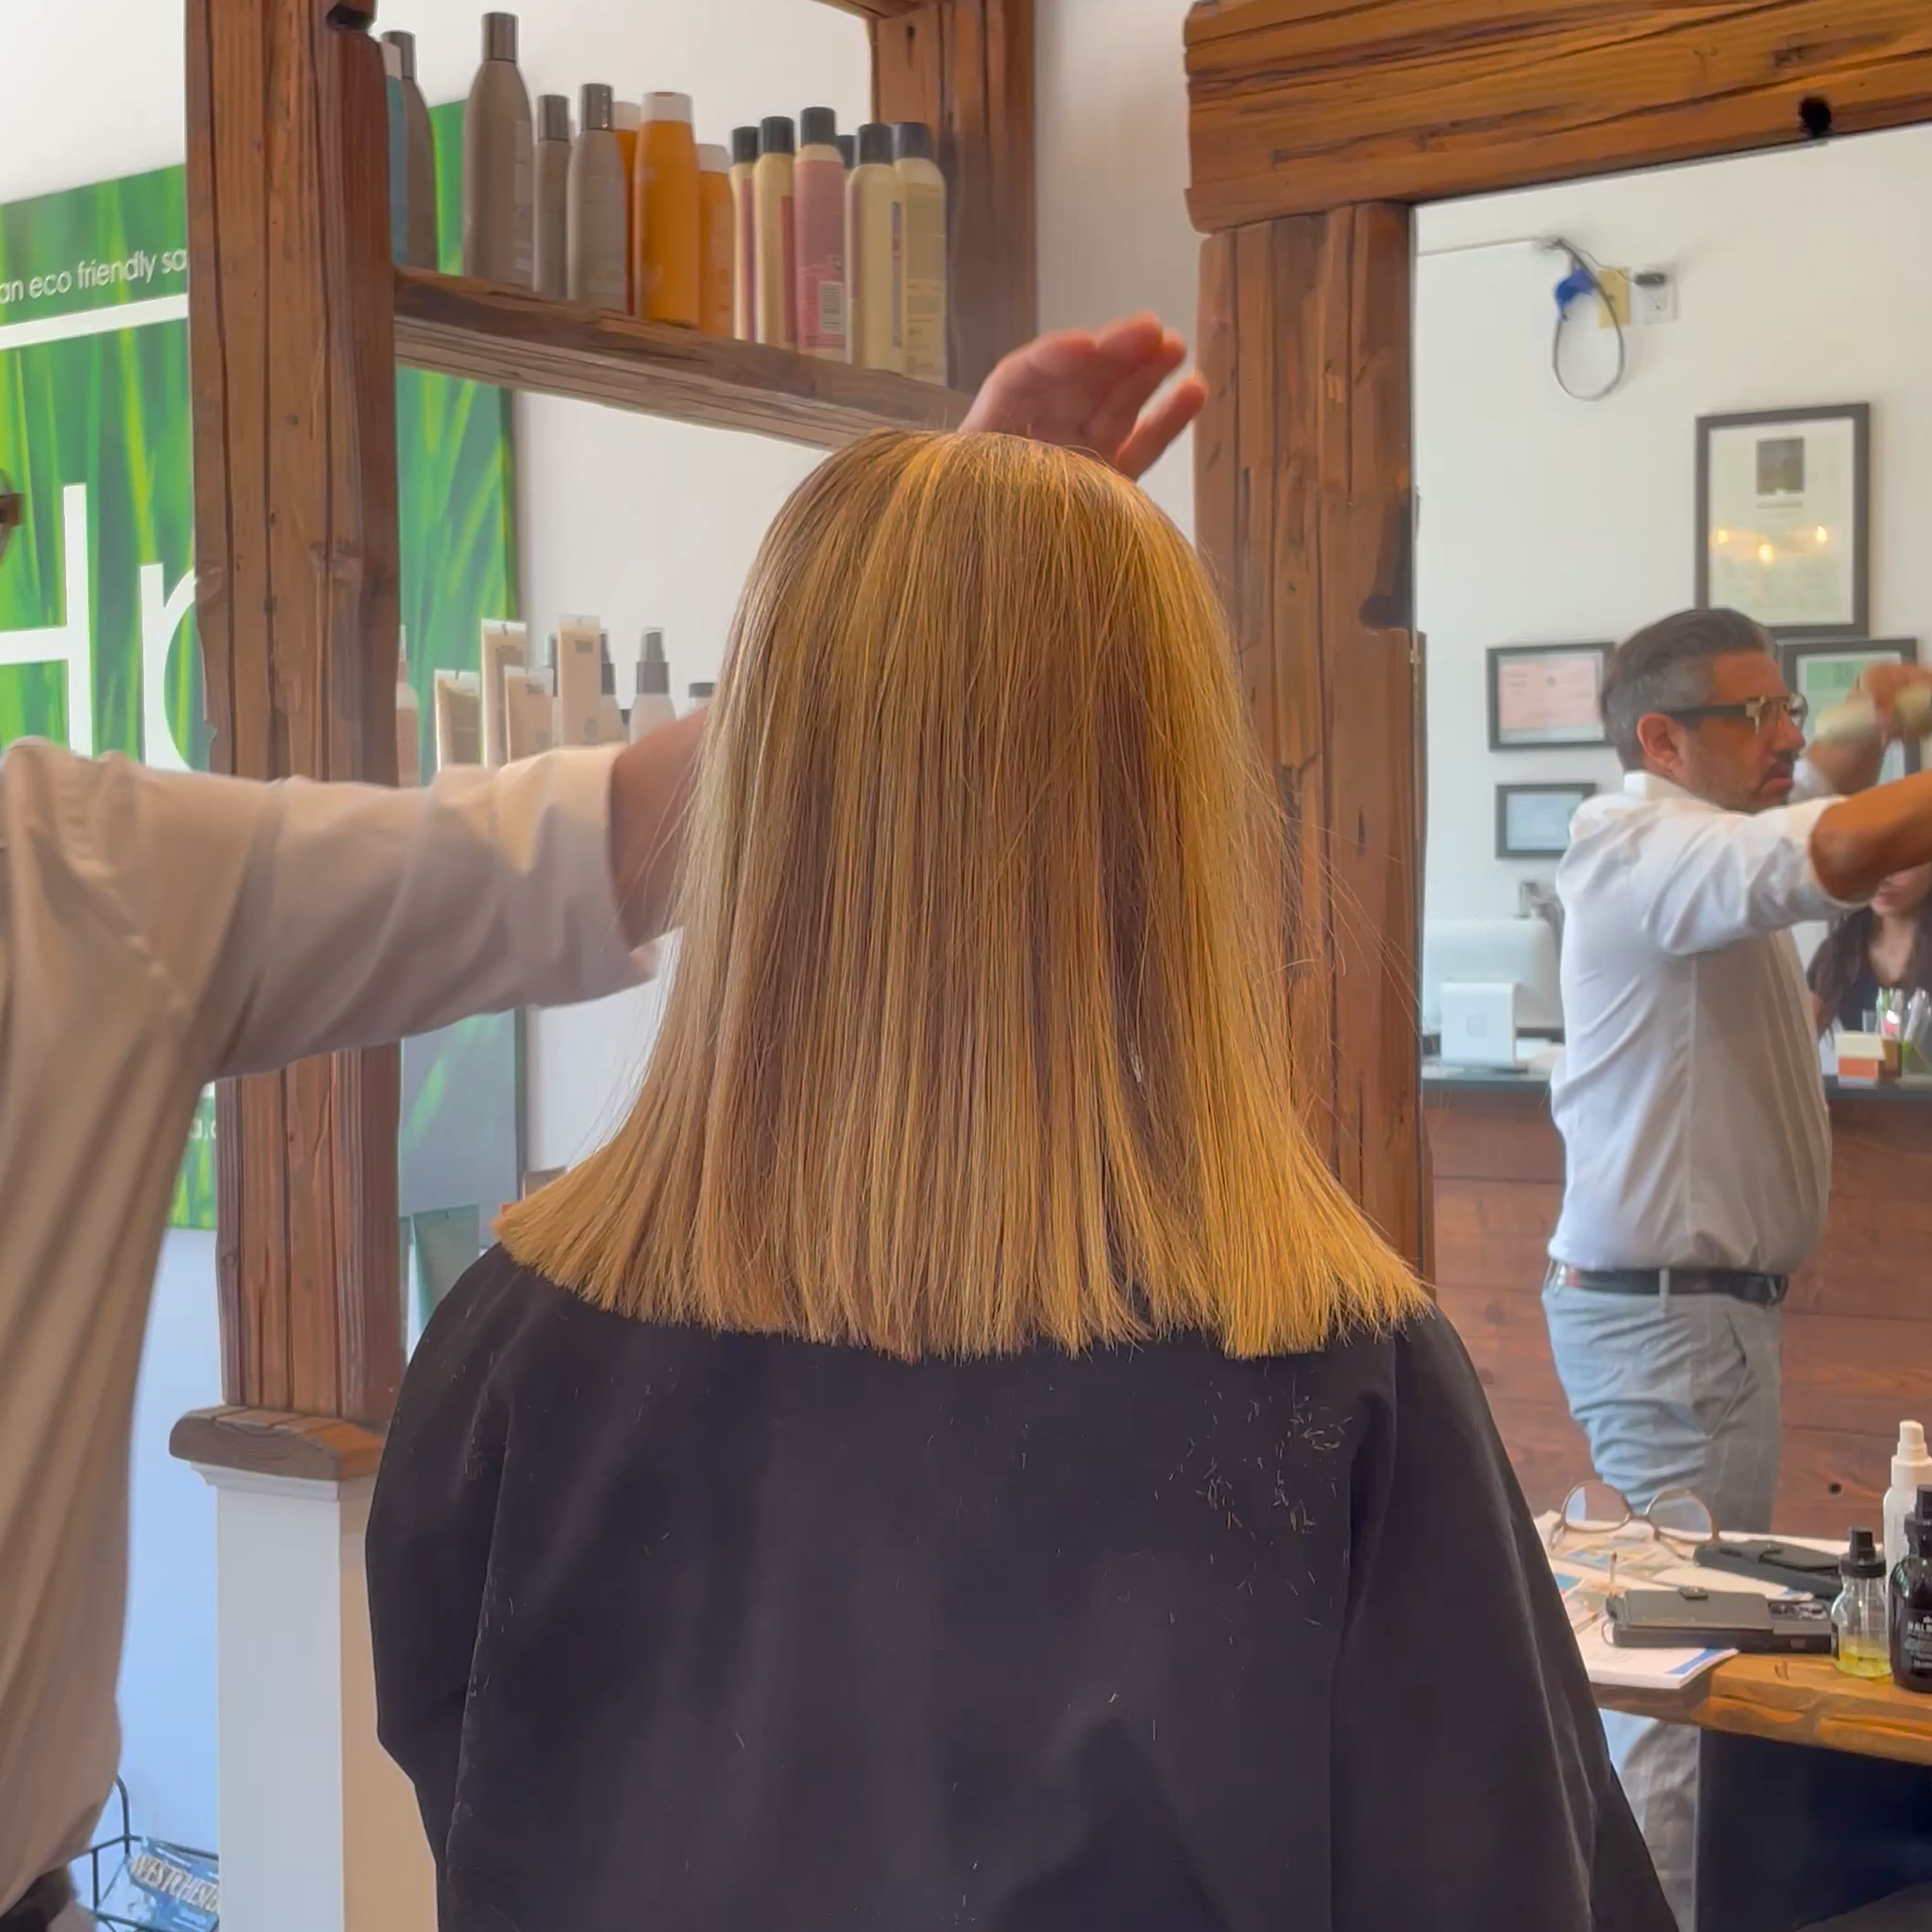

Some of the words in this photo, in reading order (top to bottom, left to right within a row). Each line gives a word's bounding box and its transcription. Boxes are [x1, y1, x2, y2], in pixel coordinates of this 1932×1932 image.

[0, 279, 24, 304] an
[29, 270, 72, 299] eco
[78, 250, 157, 291] friendly
